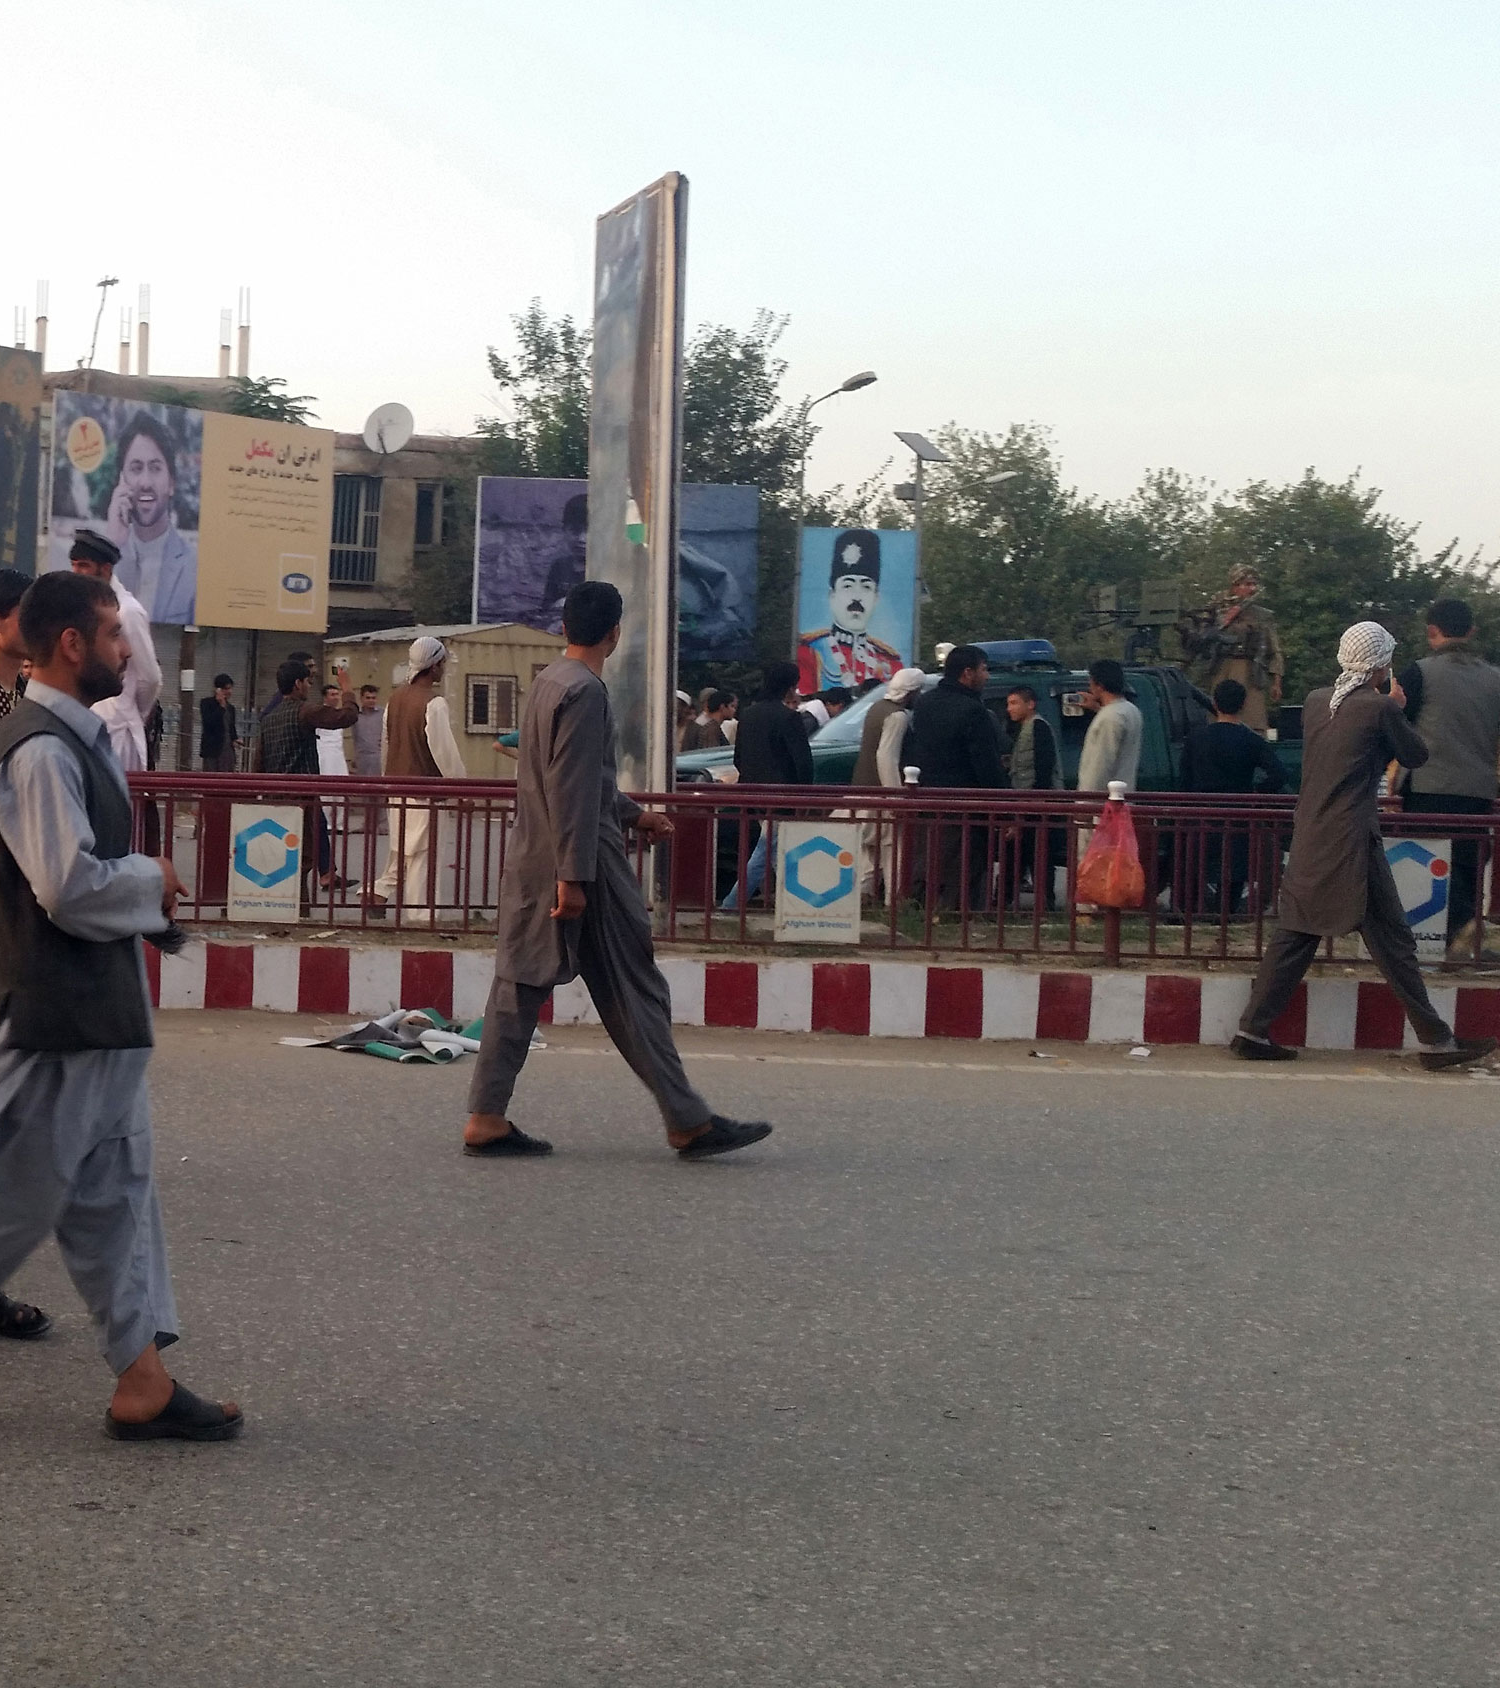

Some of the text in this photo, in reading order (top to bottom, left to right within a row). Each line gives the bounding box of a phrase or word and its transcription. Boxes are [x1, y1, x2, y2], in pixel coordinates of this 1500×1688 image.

[245, 439, 275, 461] مکمل
[277, 444, 291, 465] ان
[309, 448, 321, 469] ام
